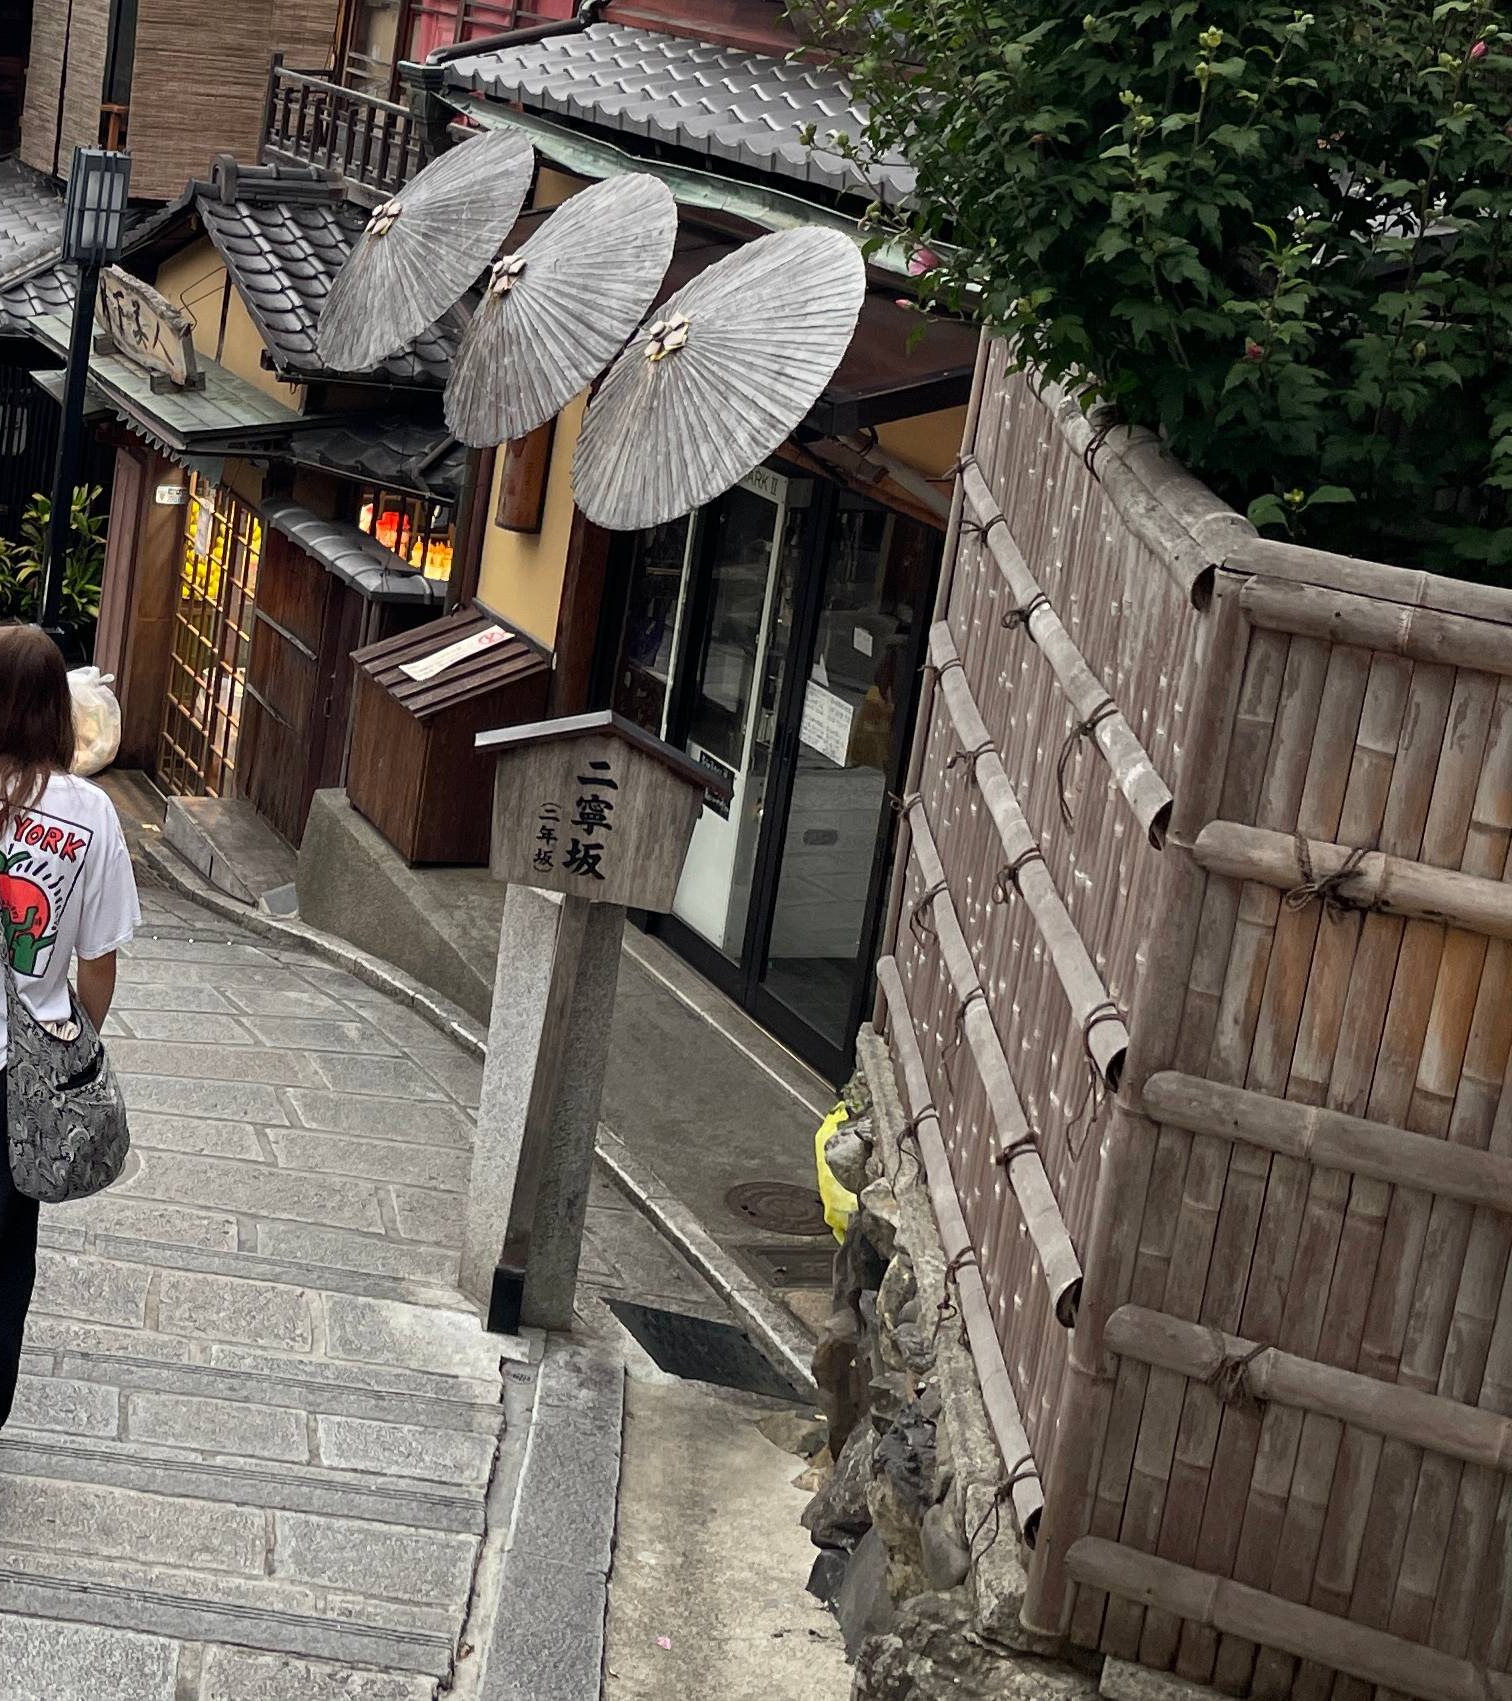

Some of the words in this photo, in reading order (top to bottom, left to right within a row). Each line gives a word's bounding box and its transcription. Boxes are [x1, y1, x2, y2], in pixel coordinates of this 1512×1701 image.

[13, 814, 86, 864] YORK
[562, 760, 619, 881] 二寧坂
